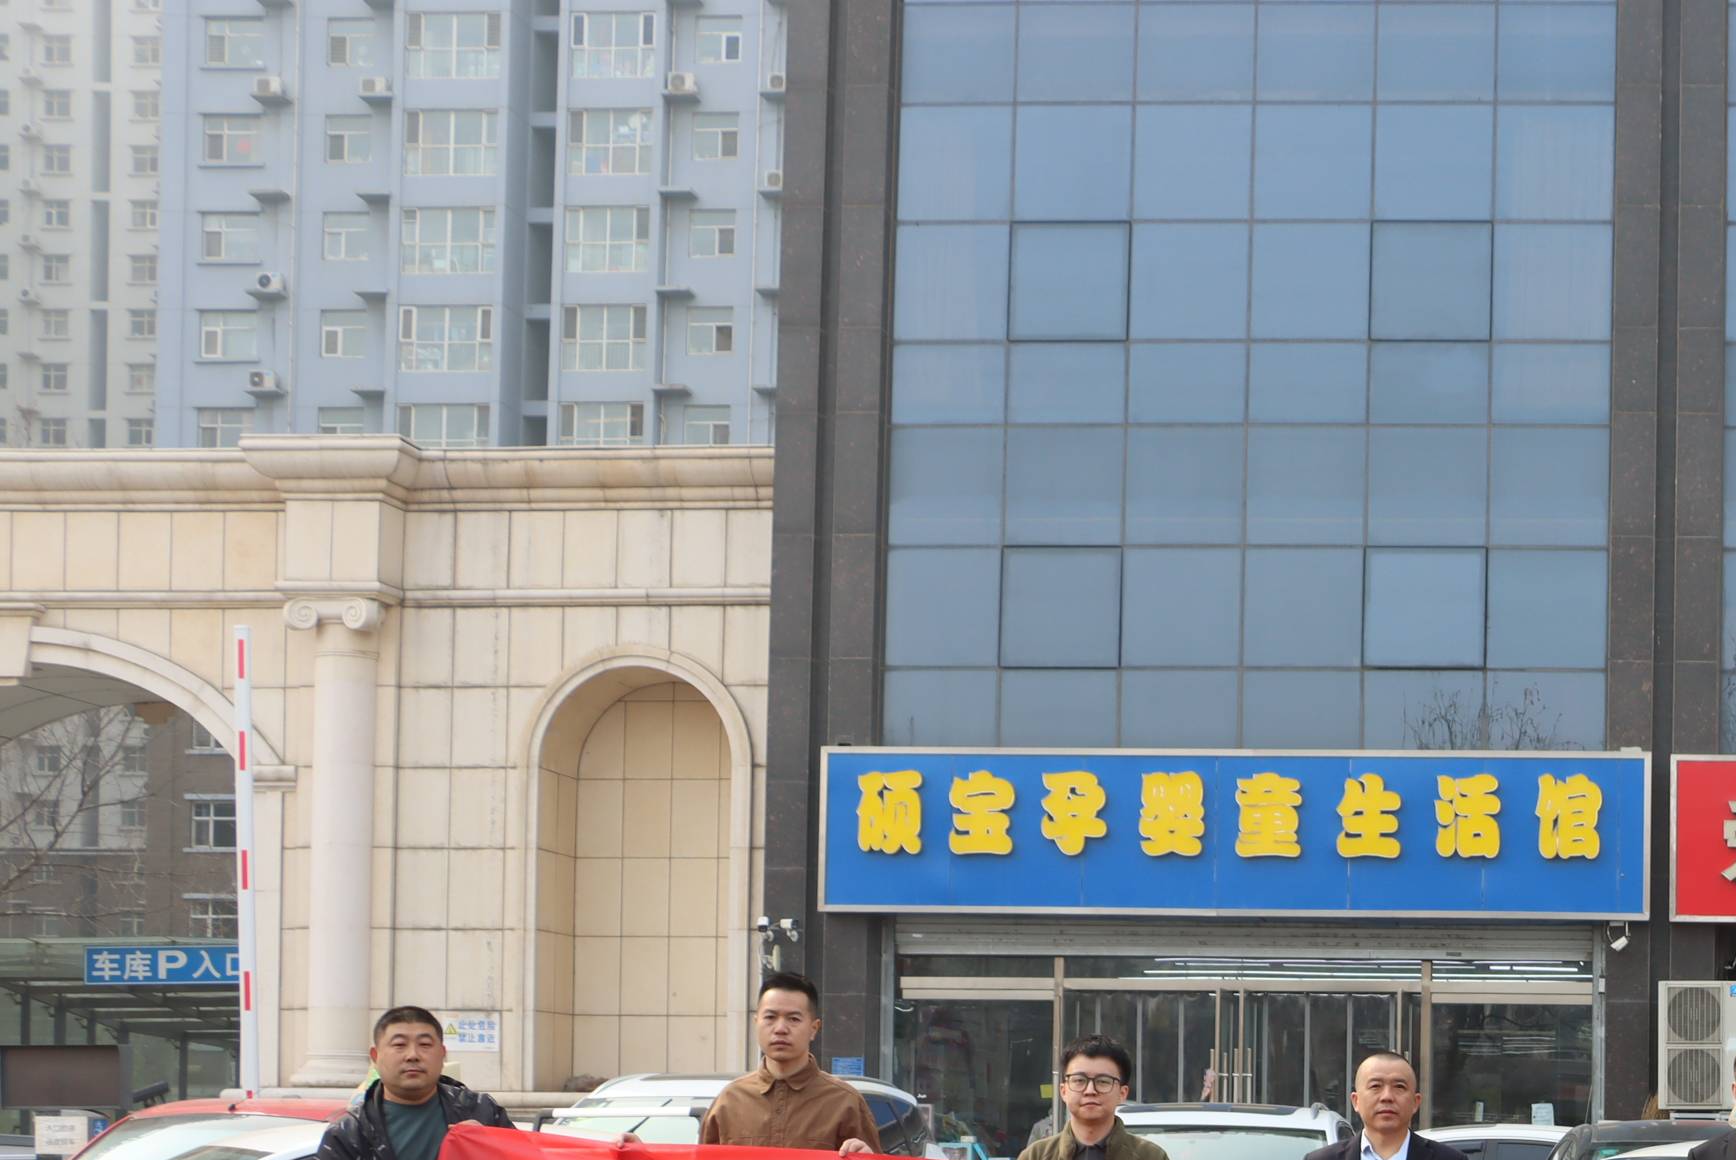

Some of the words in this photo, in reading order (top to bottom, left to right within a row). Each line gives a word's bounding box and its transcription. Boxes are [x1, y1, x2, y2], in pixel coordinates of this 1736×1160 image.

[857, 770, 1602, 859] 硕宝孕婴童生活馆
